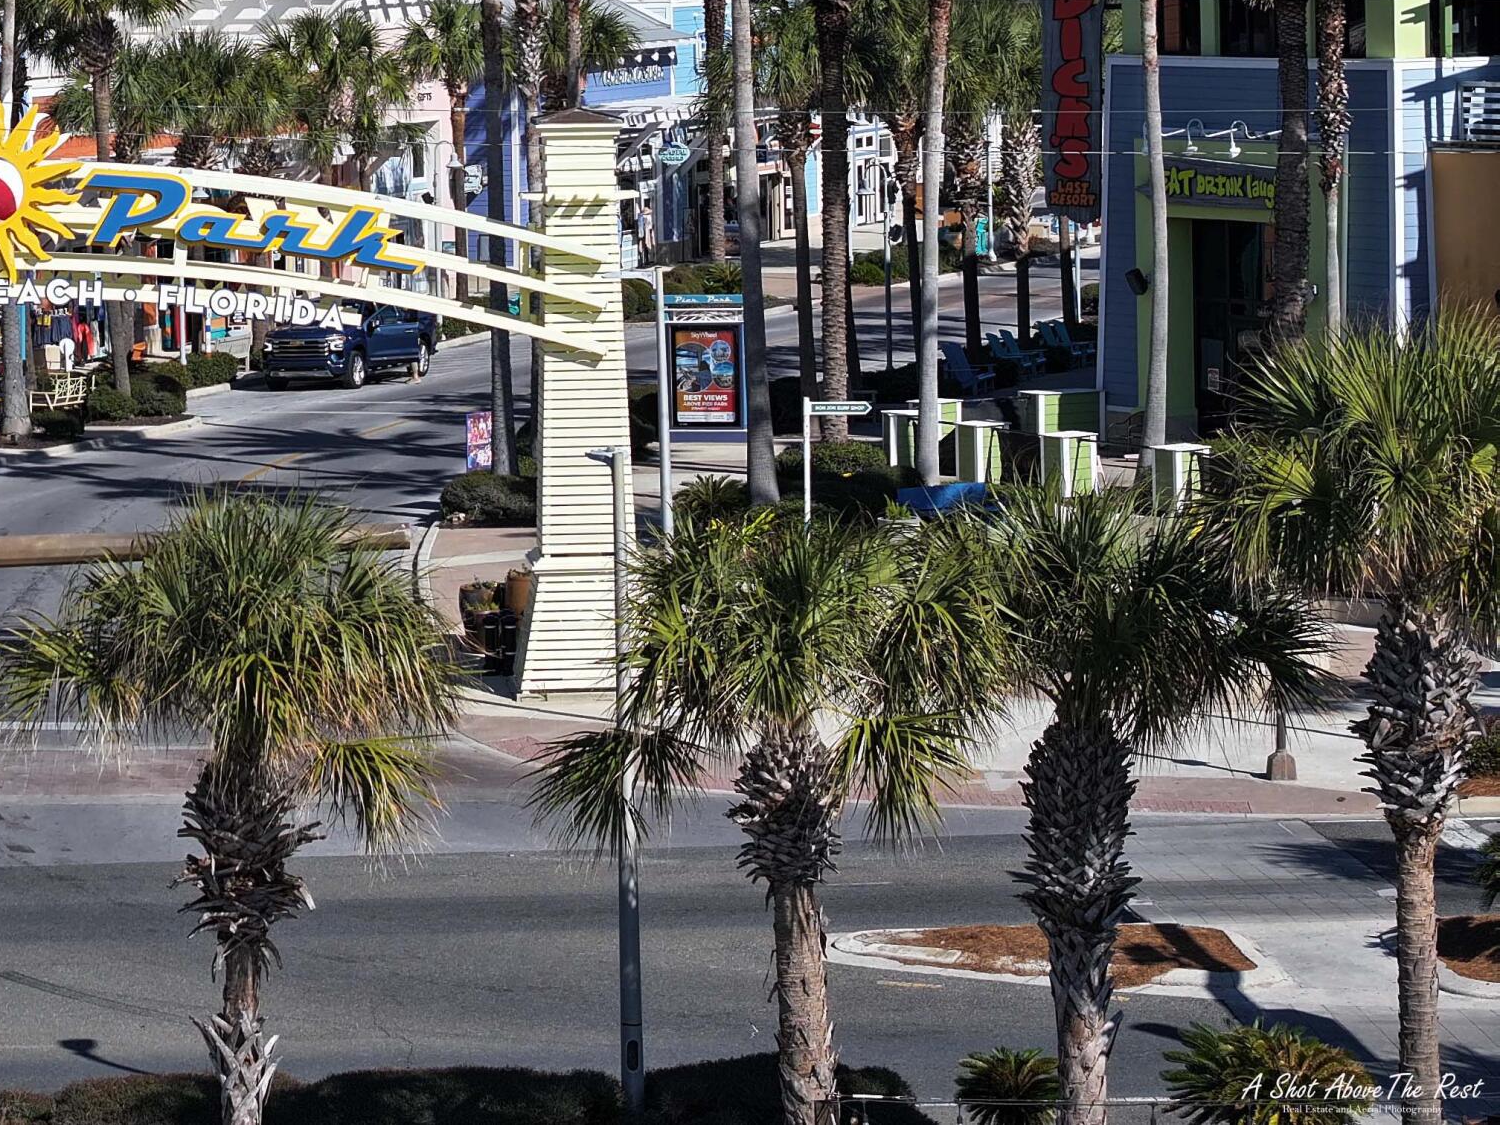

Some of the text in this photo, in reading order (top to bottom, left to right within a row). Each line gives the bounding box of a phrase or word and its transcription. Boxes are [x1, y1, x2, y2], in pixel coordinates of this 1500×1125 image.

[417, 92, 432, 101] GIFTS
[1057, 180, 1090, 194] LAST
[1196, 175, 1243, 197] DRINK
[1246, 174, 1278, 209] laug
[1050, 191, 1096, 205] RESORT
[76, 168, 426, 275] Park
[675, 295, 733, 303] Pier Park
[158, 283, 345, 332] FLORIDA
